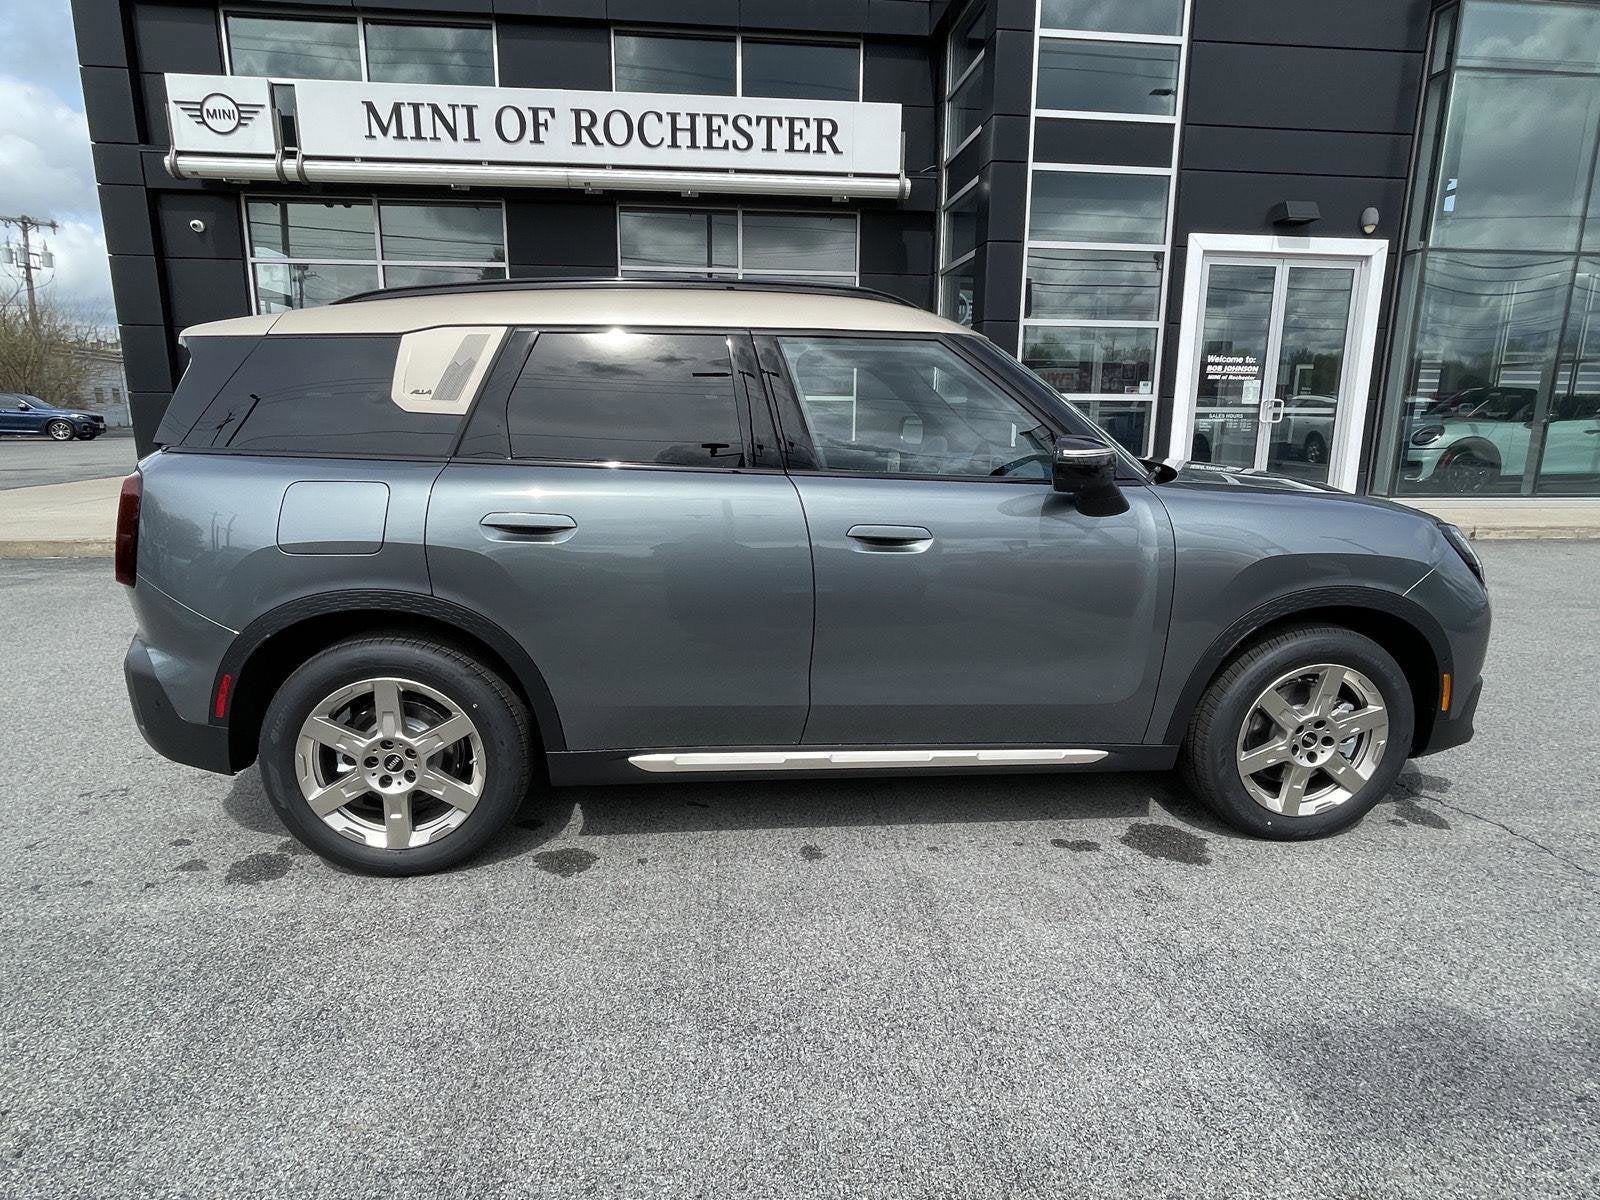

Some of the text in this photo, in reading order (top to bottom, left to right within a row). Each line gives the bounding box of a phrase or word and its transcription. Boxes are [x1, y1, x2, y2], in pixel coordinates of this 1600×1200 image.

[206, 109, 236, 121] MINI
[361, 100, 843, 155] MINI OF ROCHESTER
[1207, 354, 1257, 364] Welcome to:
[1223, 365, 1259, 373] JOHNSON
